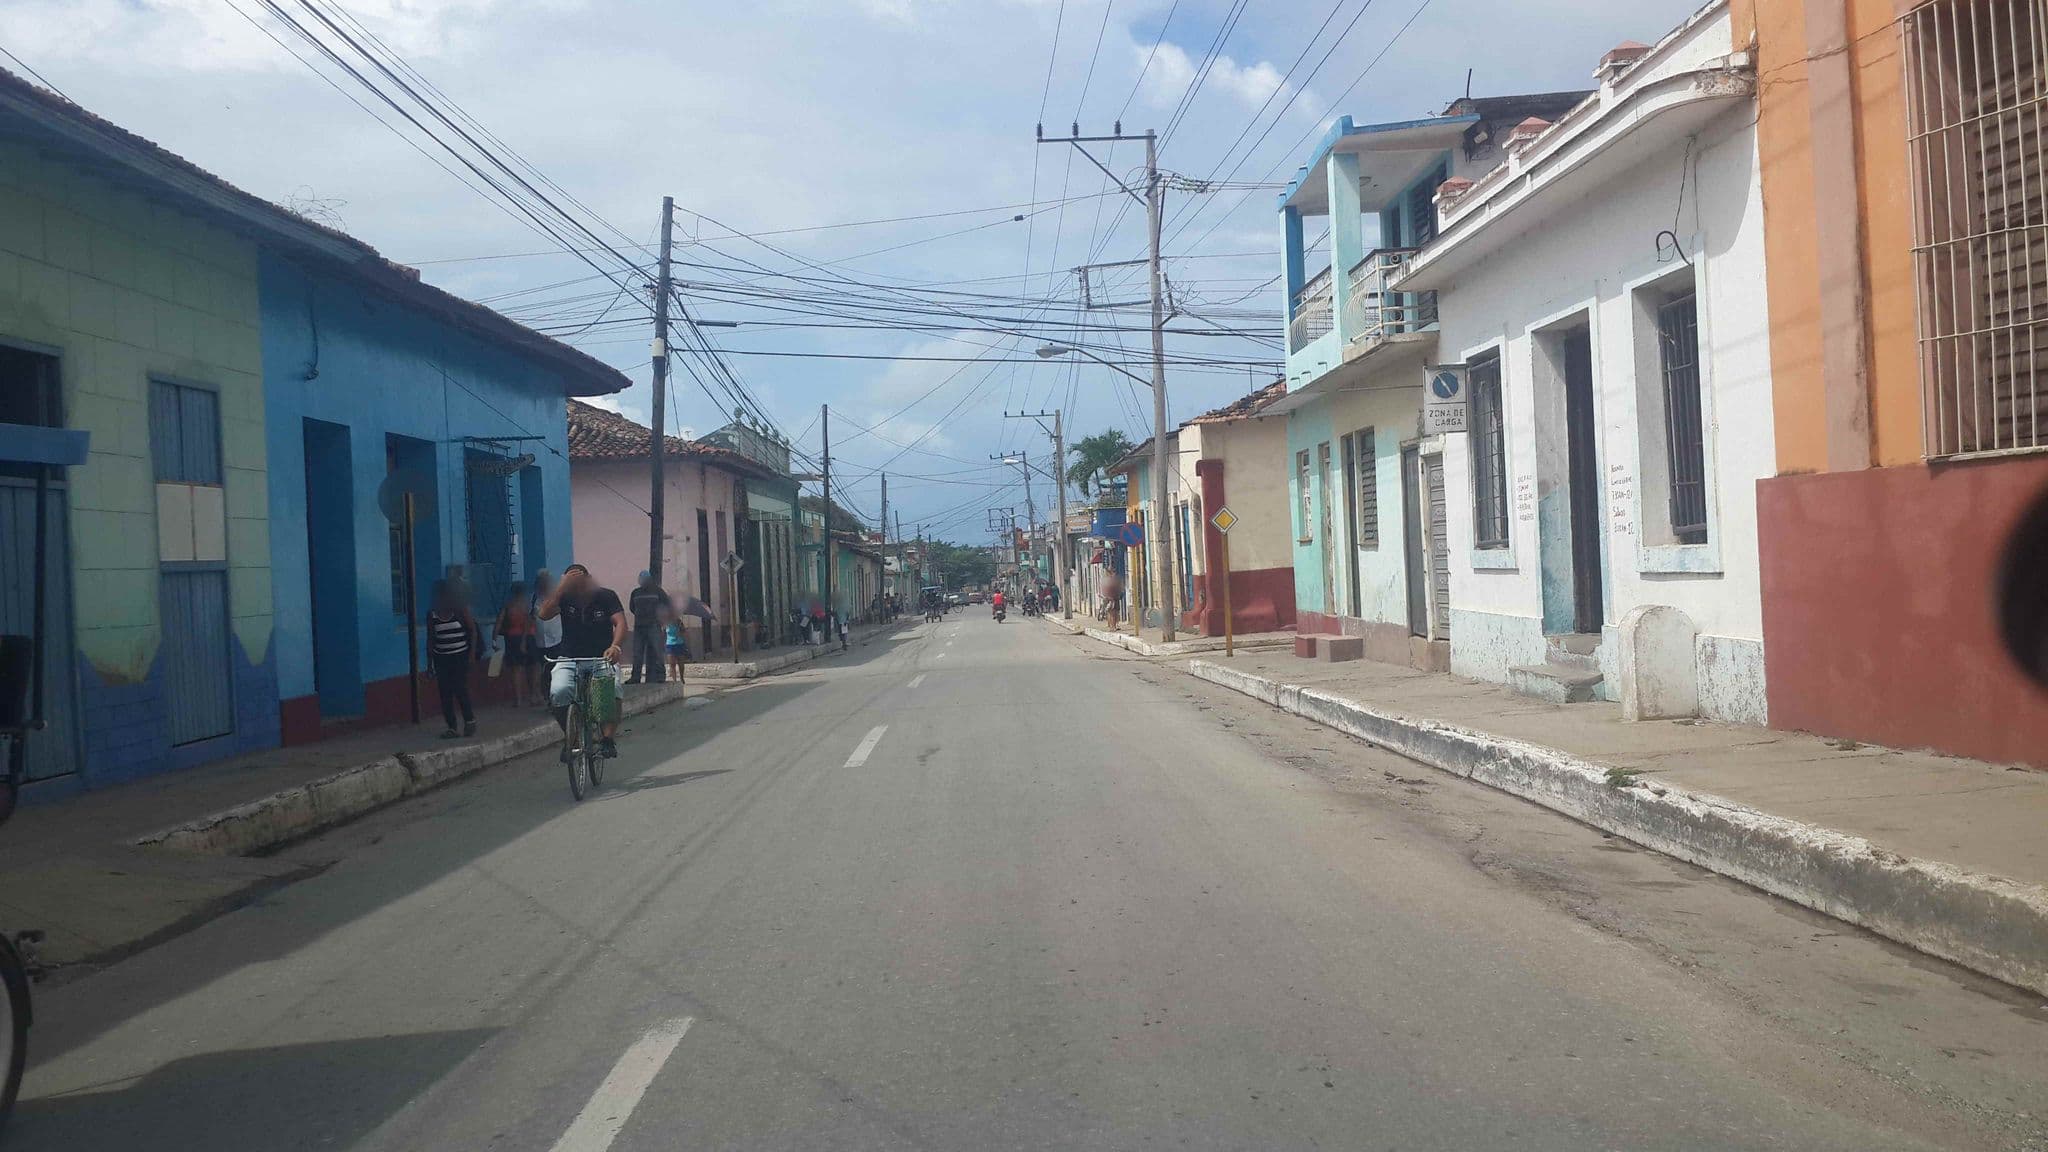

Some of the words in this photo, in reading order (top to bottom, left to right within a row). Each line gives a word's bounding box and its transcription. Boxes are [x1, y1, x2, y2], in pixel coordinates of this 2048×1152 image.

[1429, 409, 1451, 418] ZONA
[1453, 408, 1465, 417] DE
[1435, 418, 1463, 427] CARGA
